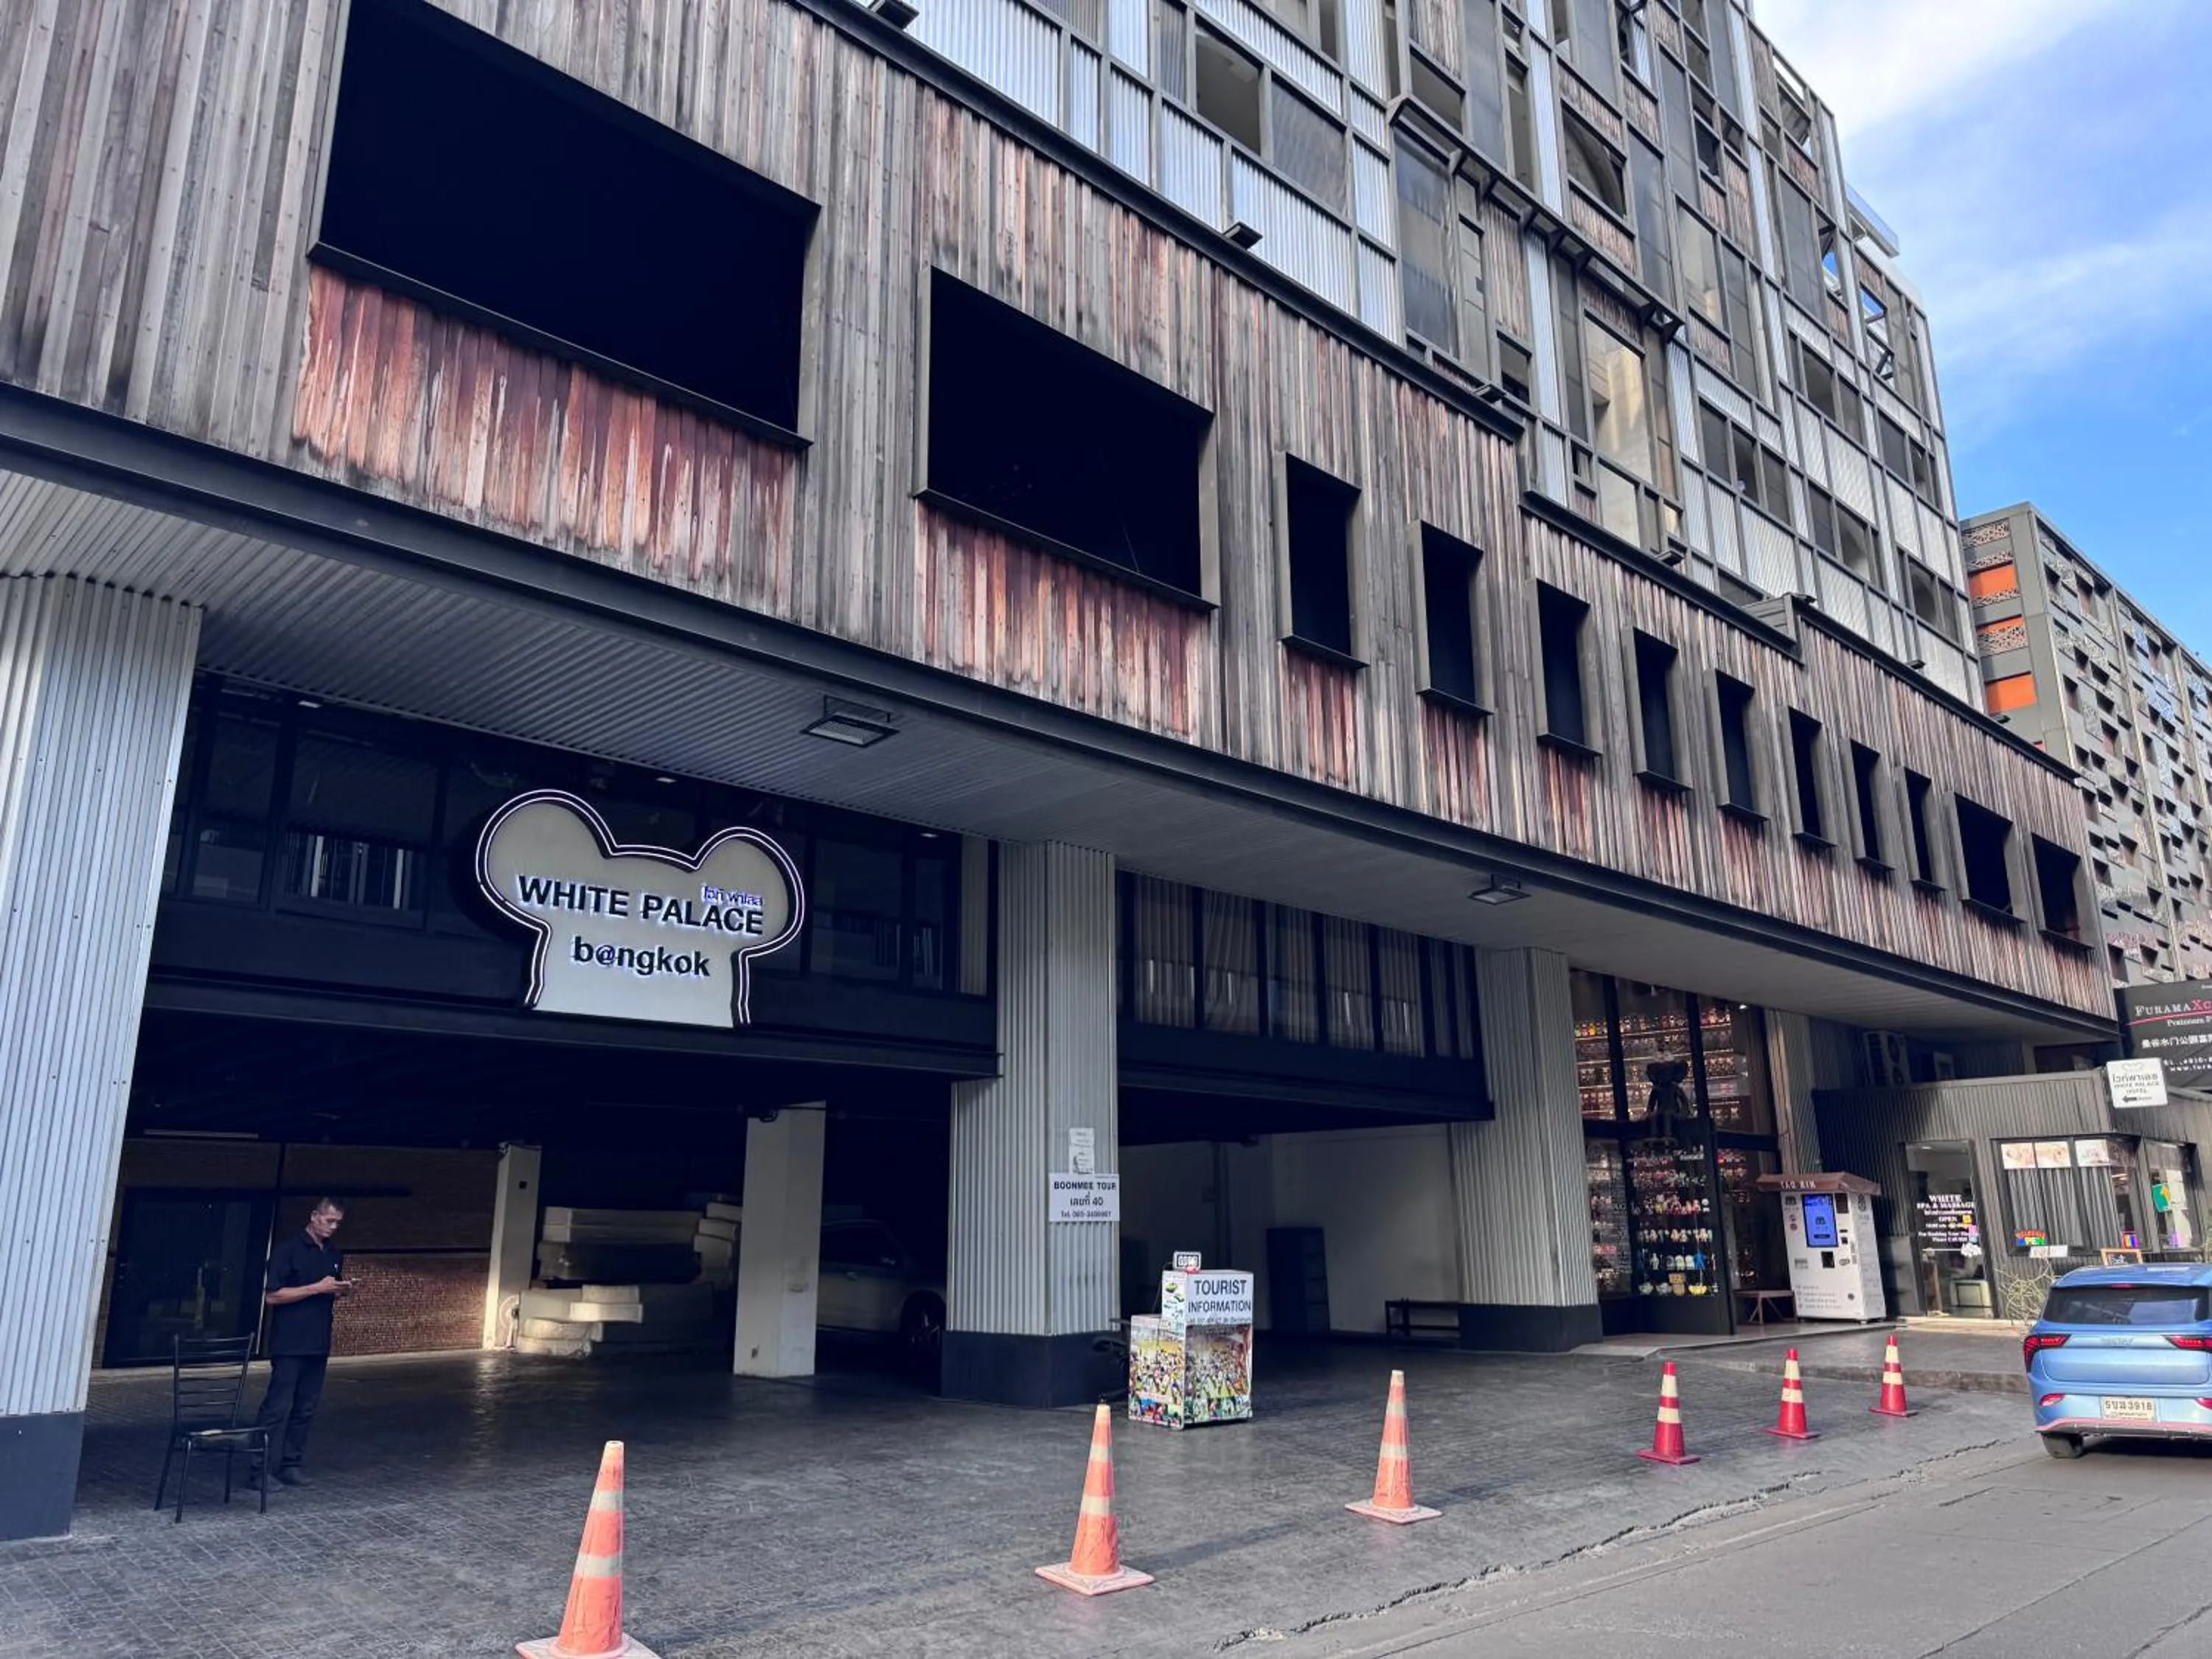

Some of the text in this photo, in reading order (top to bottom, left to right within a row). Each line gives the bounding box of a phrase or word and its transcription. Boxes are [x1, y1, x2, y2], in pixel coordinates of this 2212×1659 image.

[518, 874, 764, 935] WHITE PALACE
[573, 936, 711, 978] b@ngkok
[1096, 1181, 1116, 1190] TOUR
[1092, 1197, 1104, 1206] 40
[1194, 1279, 1248, 1295] TOURIST
[1188, 1298, 1252, 1313] INFORMATION
